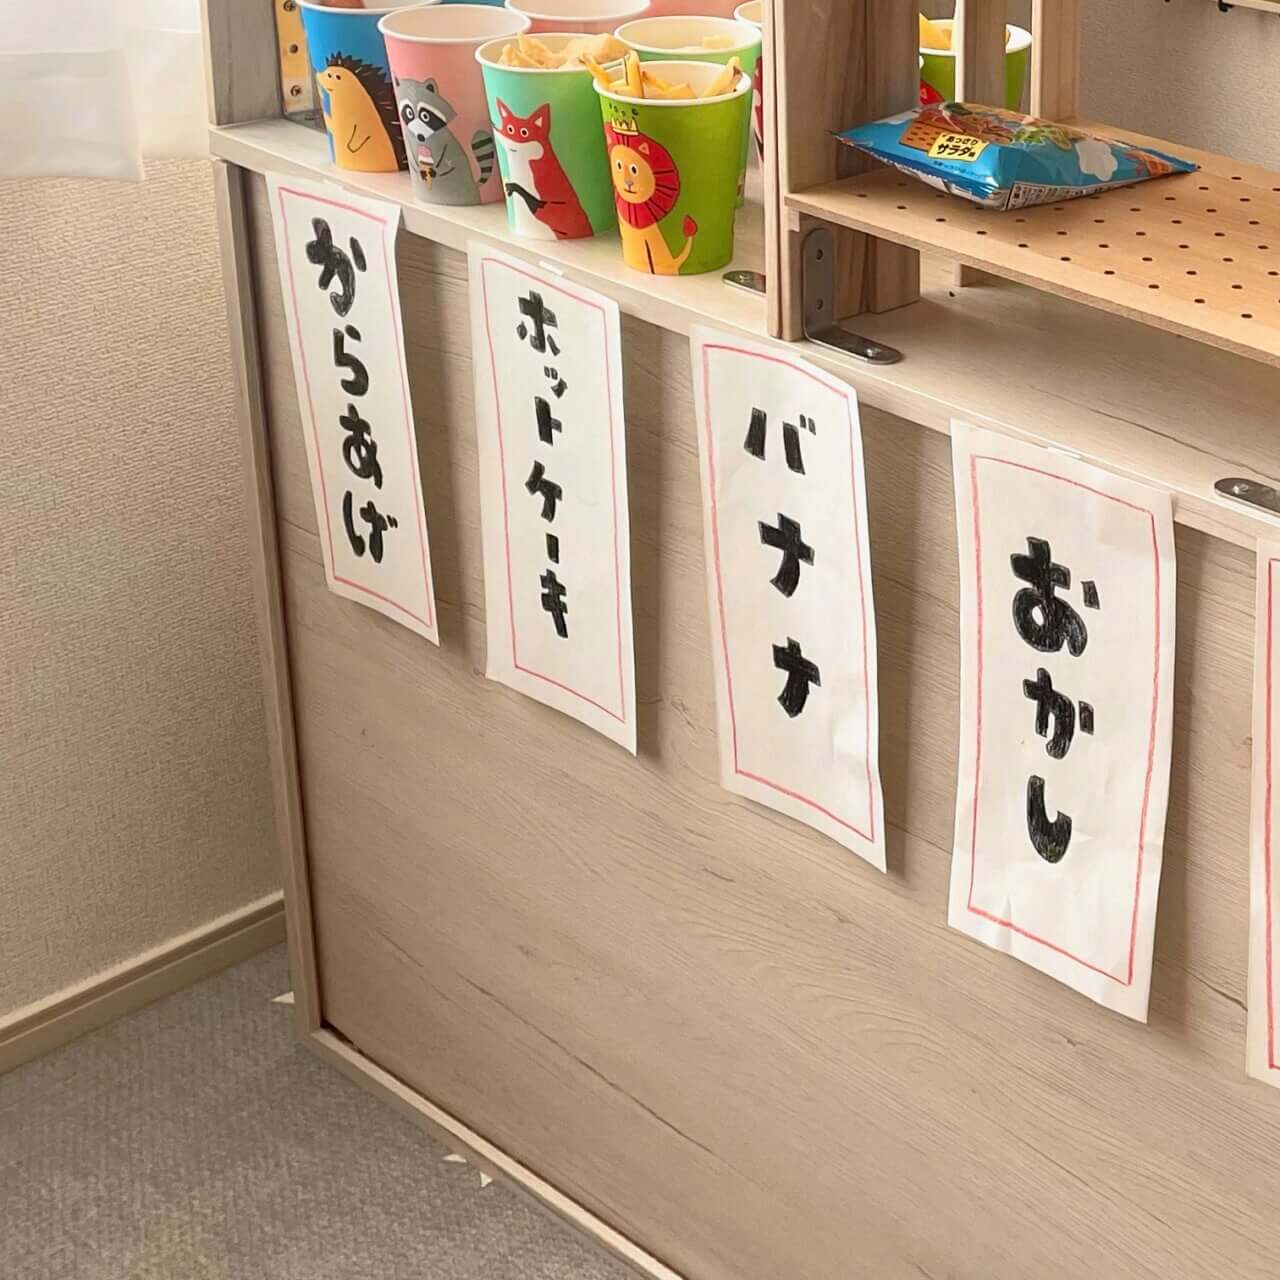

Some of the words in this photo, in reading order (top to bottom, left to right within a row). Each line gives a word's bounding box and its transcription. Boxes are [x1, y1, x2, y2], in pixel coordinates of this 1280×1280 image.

[305, 216, 398, 565] からあげ
[516, 289, 571, 640] ホットケーキ
[742, 405, 822, 719] バナナ
[1009, 535, 1101, 865] おかし
